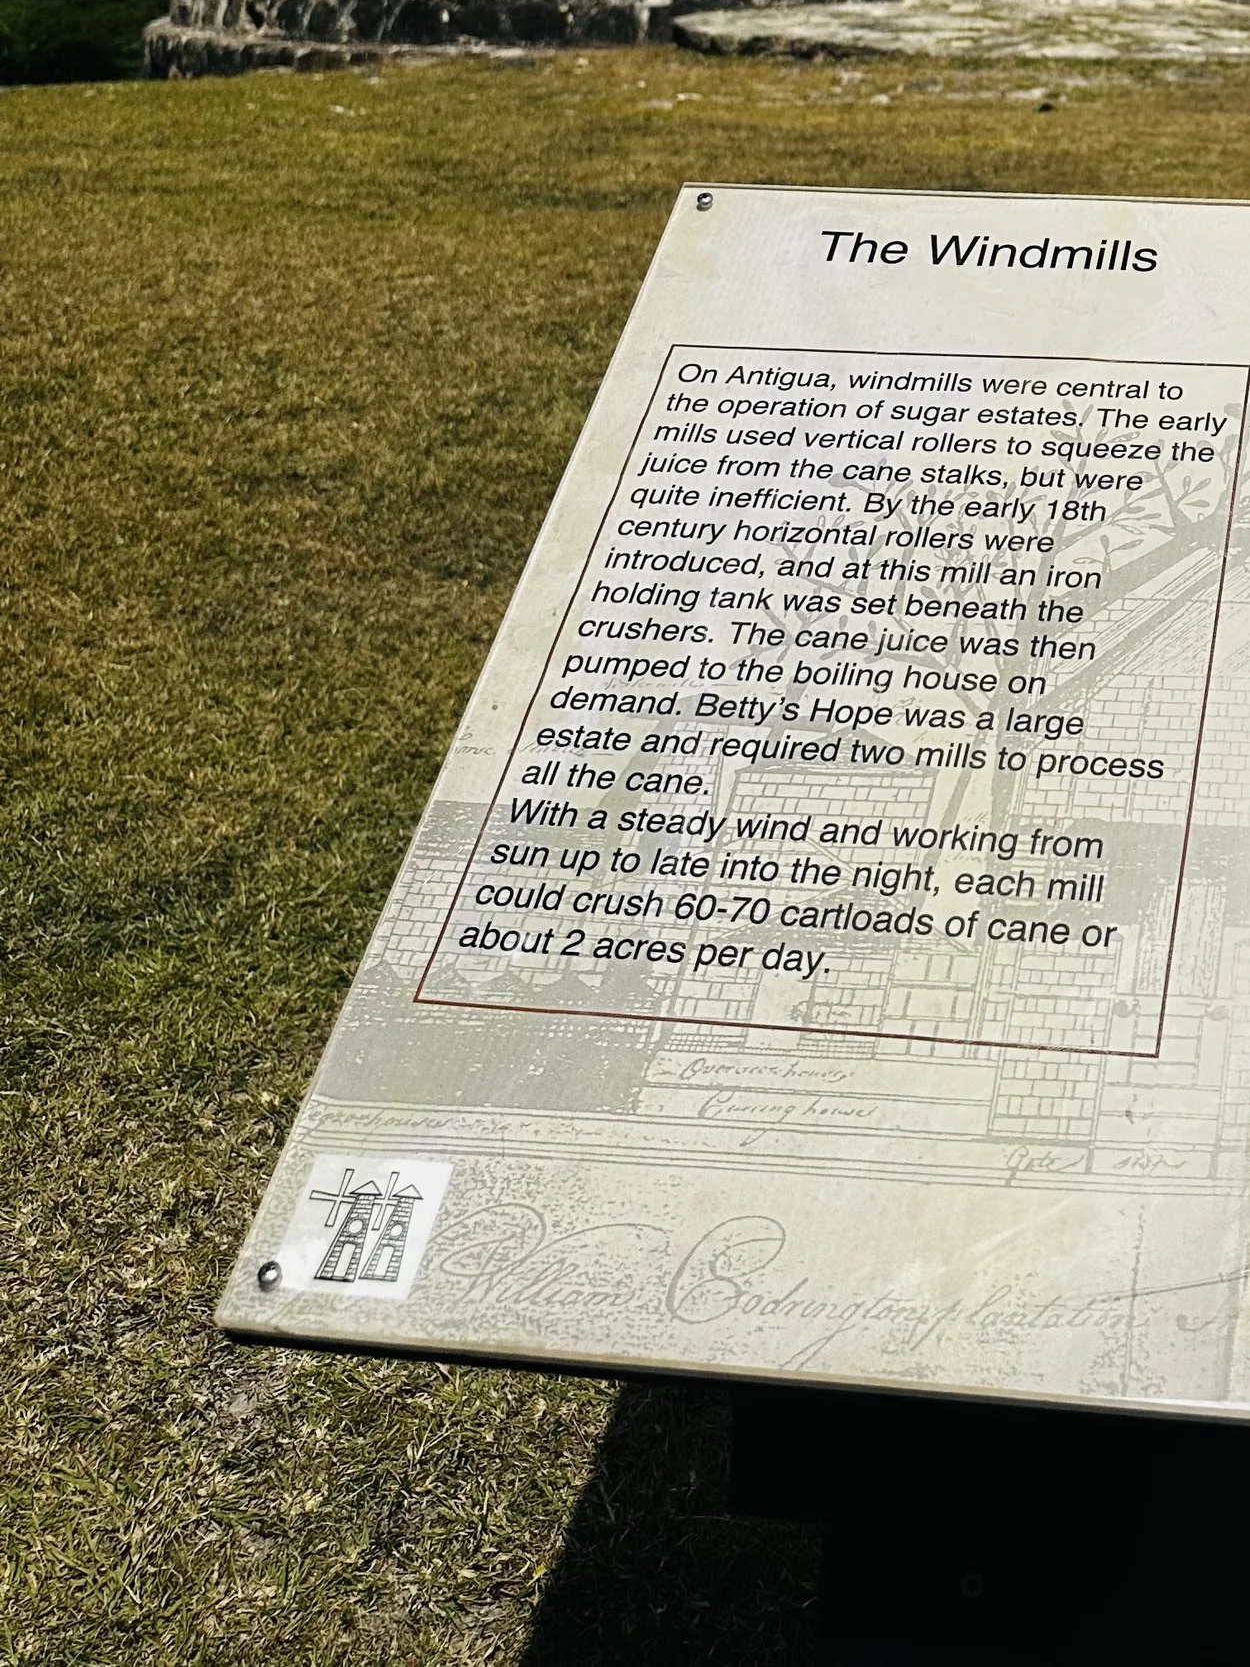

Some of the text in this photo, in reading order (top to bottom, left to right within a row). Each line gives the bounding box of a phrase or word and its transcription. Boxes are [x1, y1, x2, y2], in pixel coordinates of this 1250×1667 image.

[821, 230, 1158, 273] The Windmills
[678, 363, 1183, 401] On Antigua, windmills were central to
[666, 392, 1228, 437] the operation of sugar estates. The early
[653, 423, 1215, 463] mills used vertical rollers to squeeze the
[637, 454, 1144, 491] juice from the cane stalks, but were
[630, 486, 1106, 525] quite inefficient. By the early 18th
[604, 549, 1102, 589] introduced, and at this mill an iron
[590, 580, 1084, 624] holding tank was set beneath the
[578, 617, 1096, 660] crushers. The cane juice was then
[561, 654, 1046, 695] pumped to the boiling house on
[550, 685, 681, 716] demand.
[809, 697, 893, 731] Hope
[905, 708, 966, 729] was
[975, 711, 995, 731] a
[1005, 706, 1084, 741] large
[536, 725, 632, 751] estate
[640, 730, 703, 755] and
[709, 737, 842, 765] required
[850, 739, 905, 766] two
[915, 742, 987, 770] mills
[998, 746, 1027, 772] to
[1035, 753, 1164, 779] process
[510, 797, 1104, 861] With a steady wind and working from
[490, 843, 1105, 903] sun up to late into the night, each mill
[475, 882, 1118, 948] could crush 60-70 cartloads of cane or
